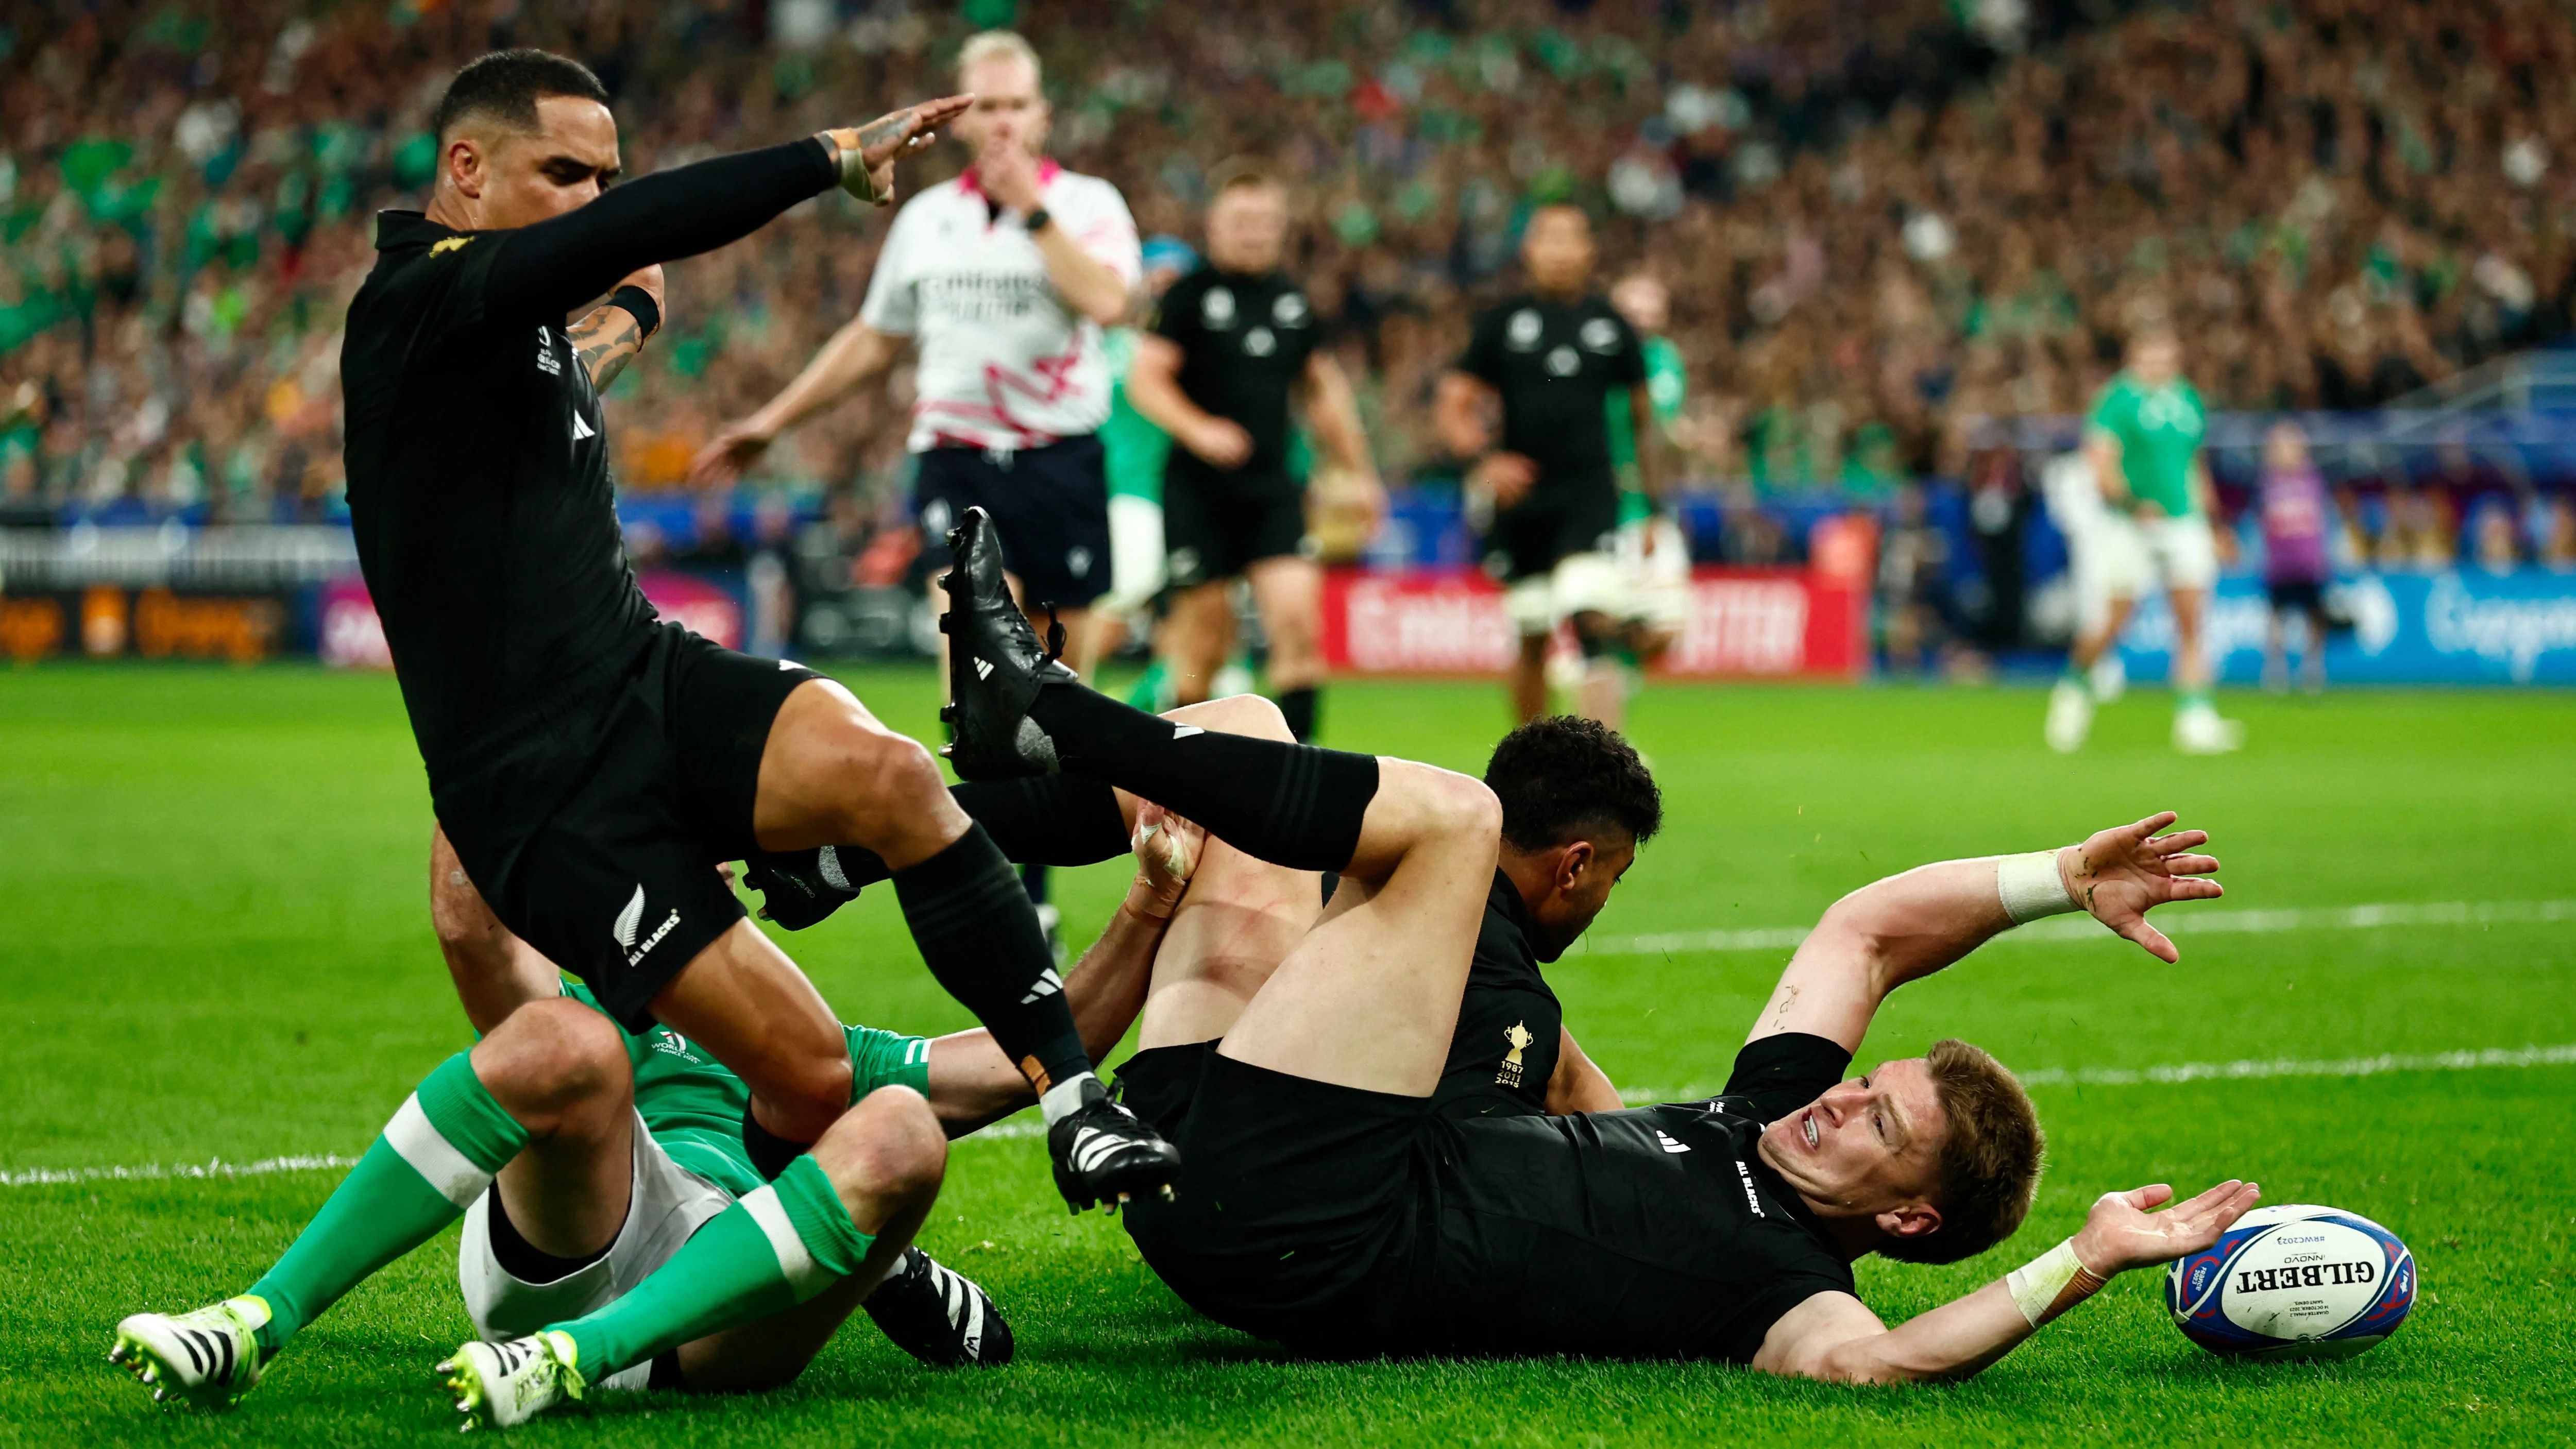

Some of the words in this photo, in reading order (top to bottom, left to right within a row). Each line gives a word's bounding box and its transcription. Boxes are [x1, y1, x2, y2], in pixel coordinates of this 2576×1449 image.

[629, 951, 645, 967] ALL
[651, 1043, 685, 1054] WORLD
[657, 1048, 681, 1056] FRANCE
[1501, 1060, 1523, 1073] 1987
[1495, 1077, 1519, 1088] 2015
[1497, 1069, 1521, 1083] 2011
[1735, 1161, 1749, 1177] ALL
[2277, 1236, 2325, 1245] #RWC2023
[2192, 1269, 2200, 1285] 2023
[2236, 1261, 2375, 1293] GILBERT
